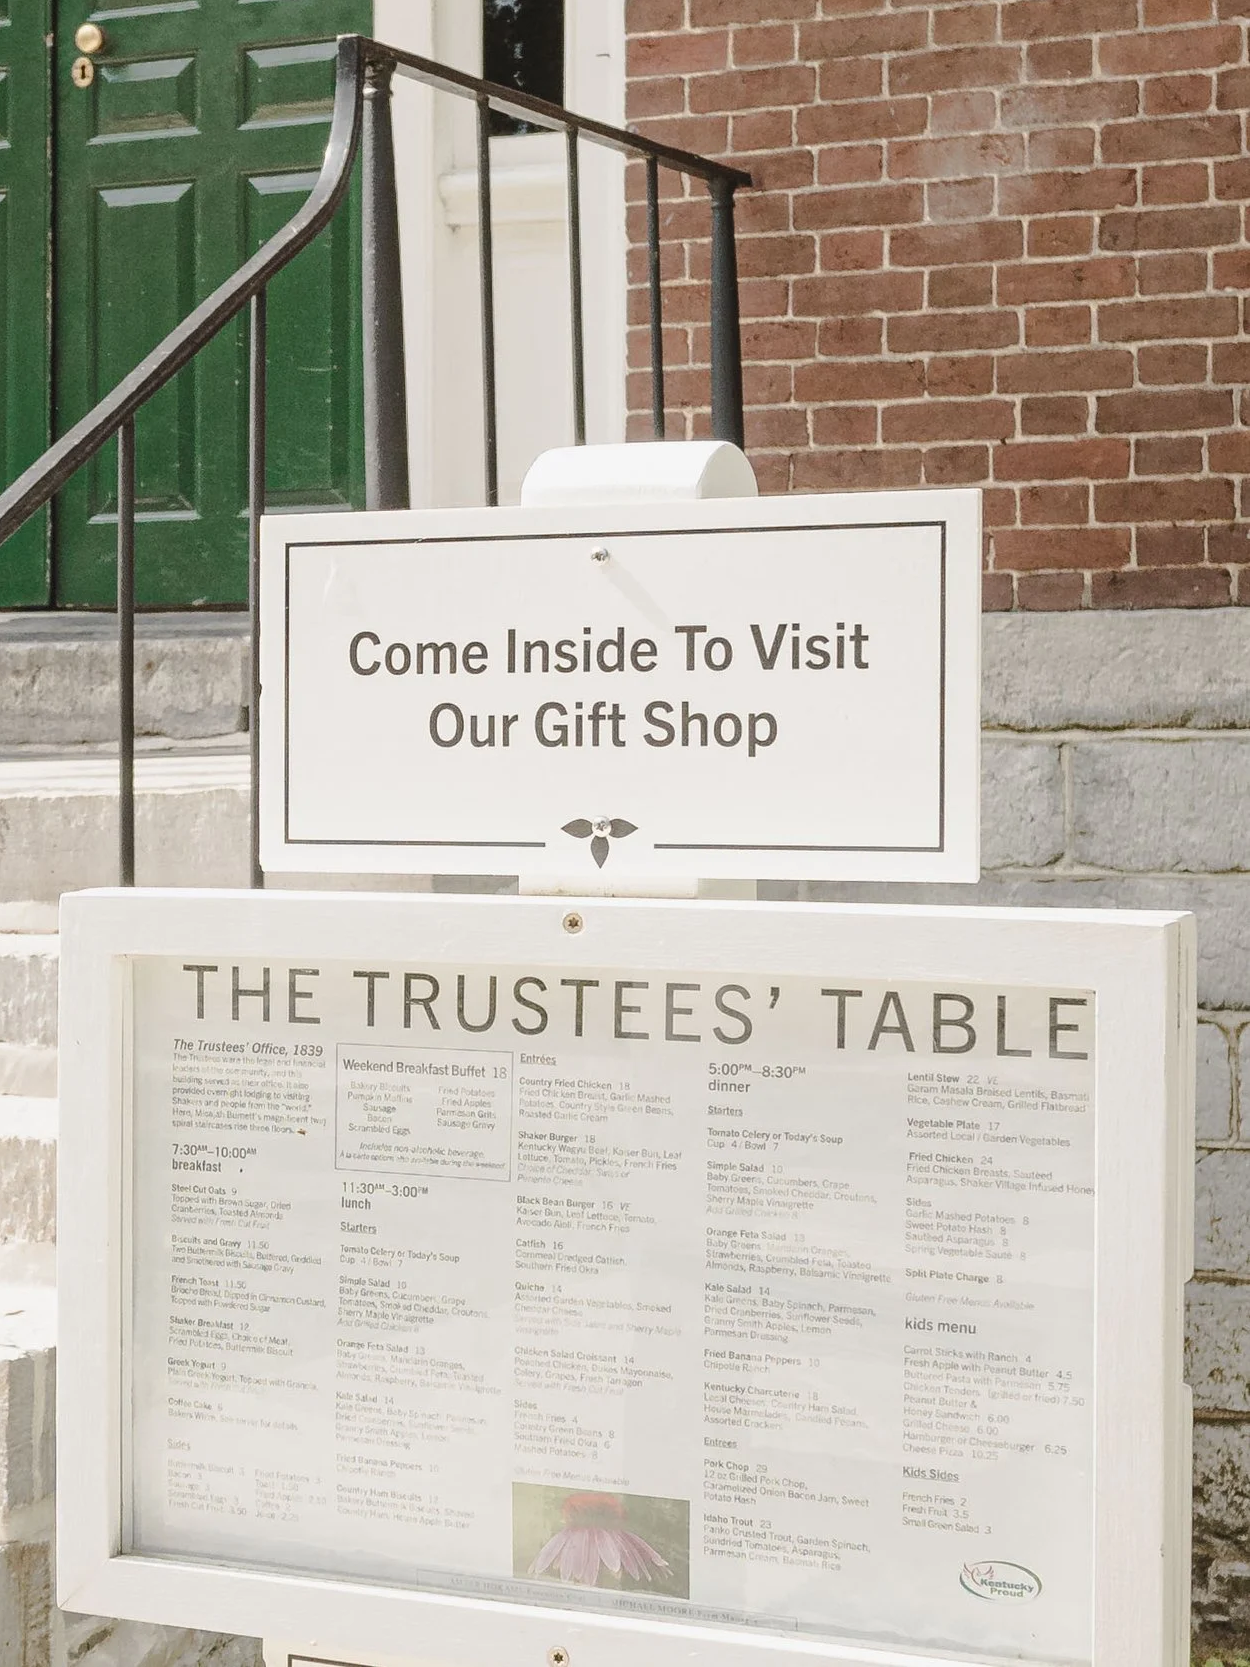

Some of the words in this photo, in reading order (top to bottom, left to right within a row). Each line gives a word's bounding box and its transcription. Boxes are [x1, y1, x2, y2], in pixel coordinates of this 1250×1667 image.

[349, 631, 488, 676] Come
[507, 626, 658, 674] Inside
[674, 625, 733, 671] To
[749, 622, 869, 670] Visit
[429, 702, 519, 748] Our
[535, 701, 626, 748] Gift
[643, 700, 778, 758] Shop
[184, 965, 322, 1025] THE
[354, 971, 782, 1045] TRUSTEES'
[822, 988, 1088, 1060] TABLE
[174, 1039, 193, 1051] The
[198, 1040, 249, 1053] Trustees'
[252, 1043, 288, 1056] Office,
[293, 1044, 323, 1057] 1839
[343, 1058, 394, 1072] Weekend
[396, 1062, 449, 1076] Breakfast
[452, 1065, 486, 1078] Buffet
[493, 1067, 507, 1079] 18
[519, 1077, 552, 1088] Country
[555, 1079, 575, 1088] Fried
[578, 1080, 612, 1090] Chicken
[619, 1082, 630, 1090] 18
[708, 1079, 750, 1093] dinner
[908, 1073, 934, 1082] Lentil
[936, 1073, 959, 1083] Stew
[967, 1075, 979, 1084] 22
[987, 1076, 998, 1085] VE
[708, 1105, 743, 1117] Starters
[907, 1118, 953, 1129] Vegetable
[956, 1120, 980, 1130] Plate
[988, 1122, 999, 1131] 17
[518, 1131, 547, 1140] Shaker
[549, 1133, 578, 1143] Burger
[585, 1135, 596, 1143] 18
[708, 1127, 740, 1137] Tomato
[742, 1129, 770, 1141] Celery
[784, 1132, 818, 1144] Today's
[820, 1134, 843, 1145] Soup
[909, 1152, 932, 1162] Fried
[935, 1154, 973, 1164] Chicken
[981, 1156, 993, 1164] 24
[172, 1159, 221, 1172] breakfast
[707, 1161, 737, 1172] Simple
[739, 1163, 764, 1172] Salad
[772, 1165, 783, 1173] 10
[342, 1197, 371, 1209] lunch
[517, 1196, 540, 1204] Black
[543, 1197, 564, 1207] Bean
[567, 1199, 594, 1210] Burger
[602, 1201, 613, 1210] 16
[620, 1203, 631, 1211] VE
[340, 1222, 377, 1234] Starters
[516, 1239, 545, 1248] Catfish
[553, 1241, 563, 1250] 16
[906, 1268, 927, 1279] Split
[929, 1270, 953, 1280] Plate
[956, 1271, 989, 1284] Charge
[996, 1275, 1003, 1284] 8
[705, 1283, 724, 1292] Kale
[727, 1285, 751, 1294] Salad
[759, 1287, 770, 1295] 14
[905, 1317, 933, 1331] kids
[938, 1320, 977, 1334] menu
[704, 1459, 724, 1469] Pork
[726, 1461, 749, 1472] Chop
[756, 1464, 768, 1473] 29
[902, 1466, 927, 1478] Kids
[929, 1469, 960, 1482] Sides
[902, 1492, 932, 1502] French
[934, 1495, 955, 1505] Fries
[960, 1498, 967, 1506] 2
[704, 1513, 728, 1524] Idaho
[731, 1516, 753, 1527] Trout
[760, 1520, 772, 1529] 23
[981, 1578, 1034, 1593] Kentucky
[990, 1587, 1024, 1597] Proud
